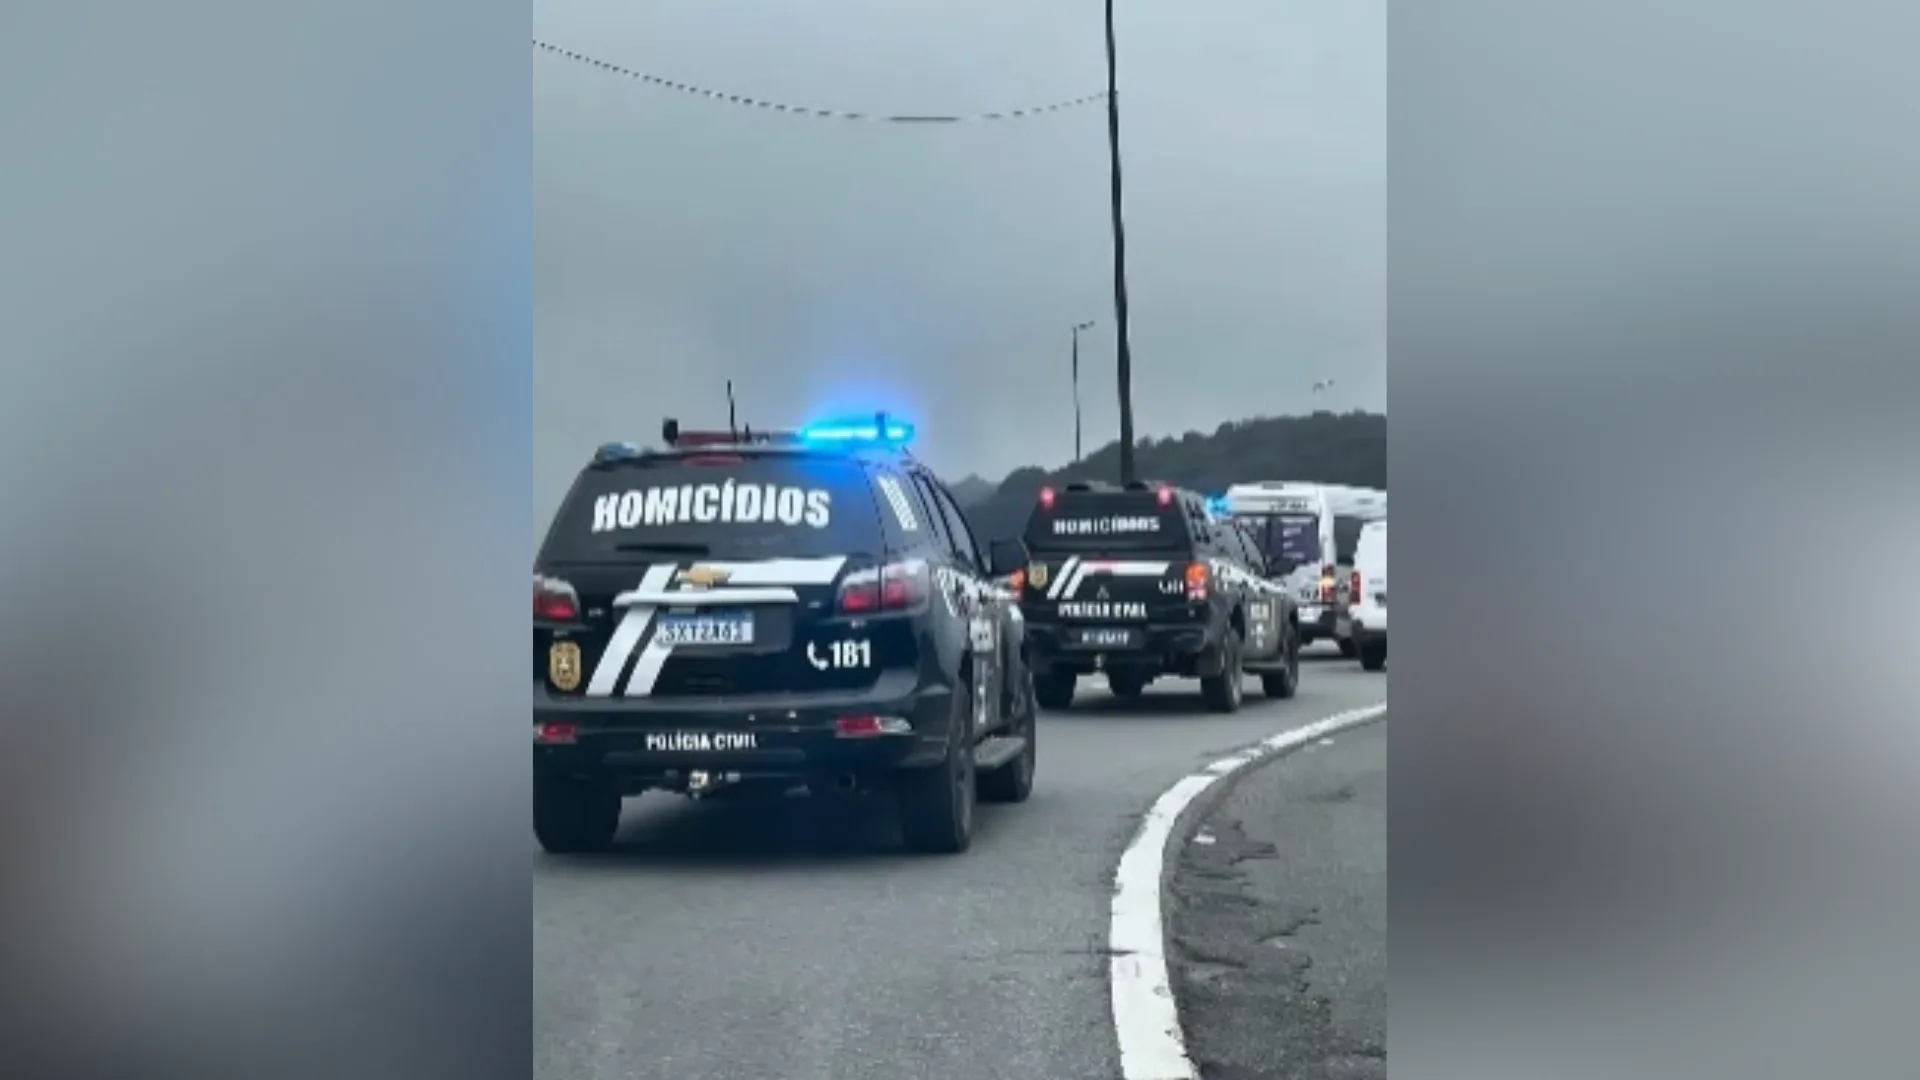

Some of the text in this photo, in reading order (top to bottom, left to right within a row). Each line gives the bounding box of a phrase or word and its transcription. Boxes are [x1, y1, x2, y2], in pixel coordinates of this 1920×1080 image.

[591, 477, 831, 533] HOMICÍDIOS
[828, 639, 871, 668] 181
[646, 728, 758, 751] POLÍCIA CIVIL
